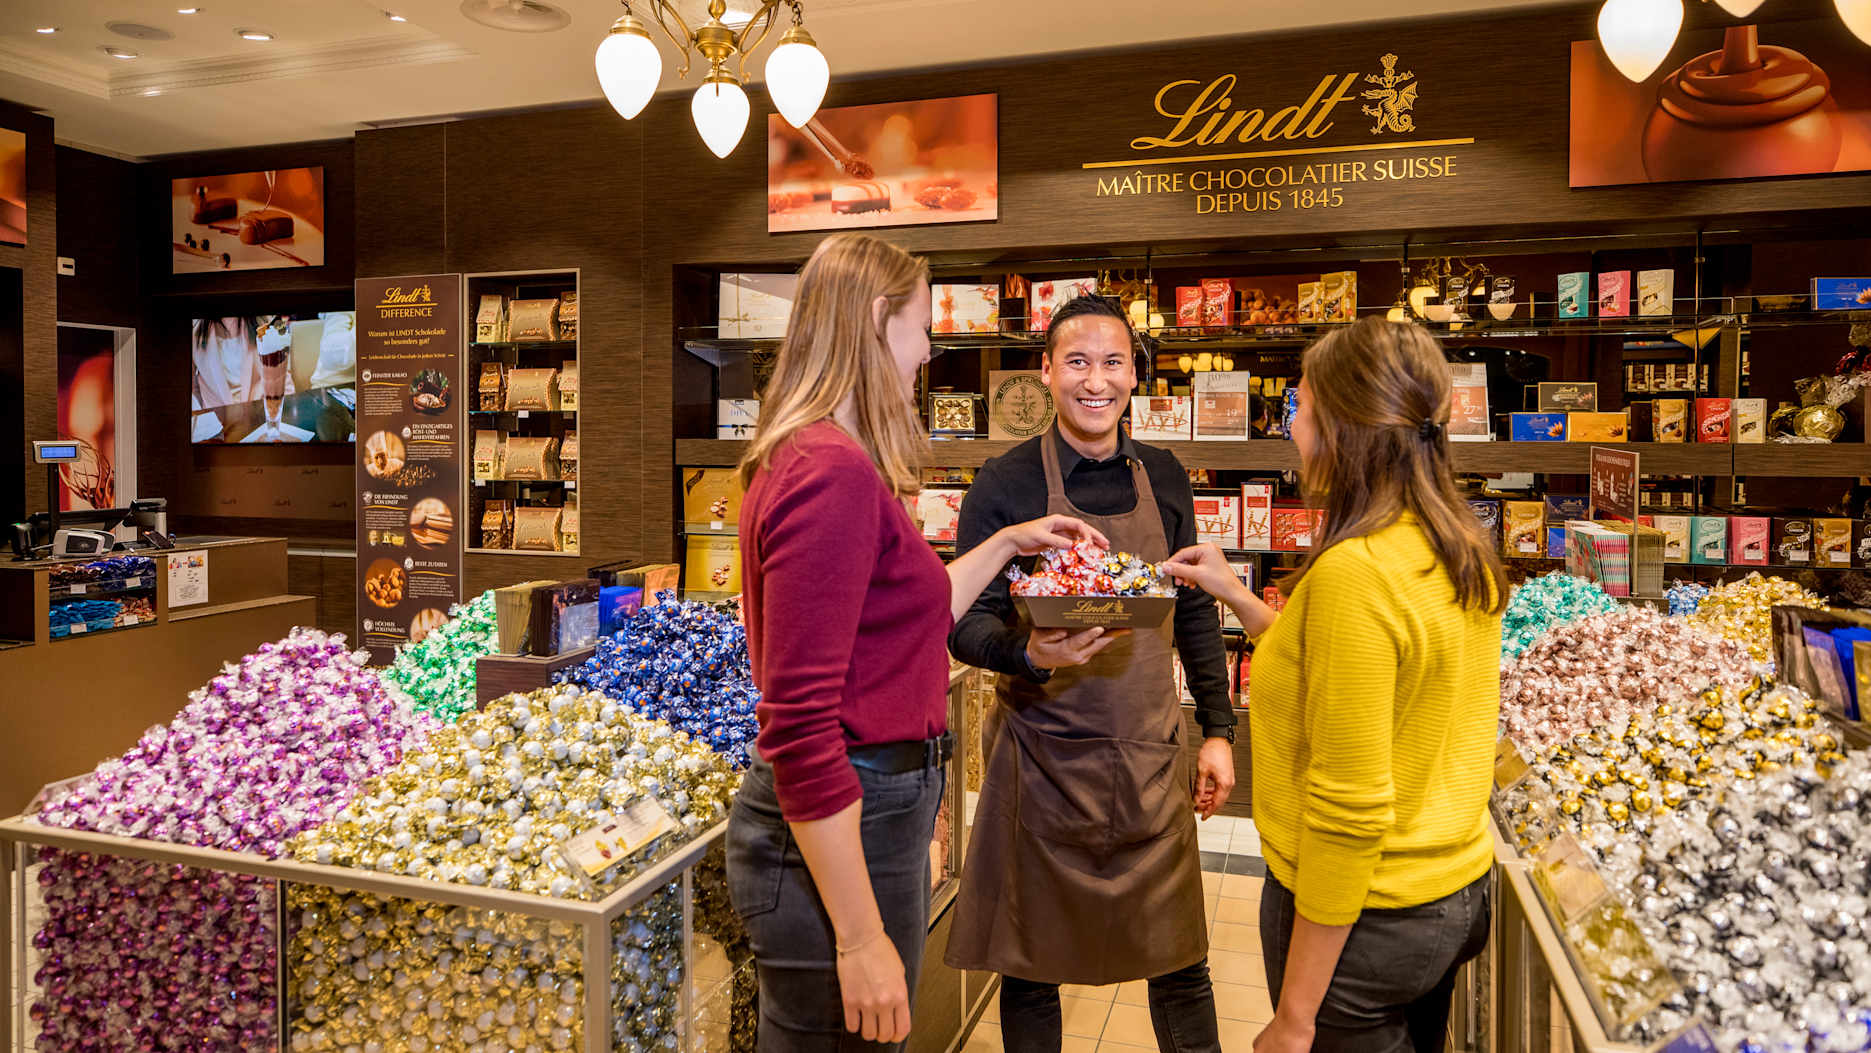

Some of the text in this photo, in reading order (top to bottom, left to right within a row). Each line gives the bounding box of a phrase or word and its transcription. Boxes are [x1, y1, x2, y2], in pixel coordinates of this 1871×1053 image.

[1130, 72, 1360, 150] Lindt
[1096, 156, 1457, 197] MAÎTRE CHOCOLATIER SUISSE
[1196, 187, 1344, 215] DEPUIS 1845
[381, 286, 422, 304] Lindt
[381, 307, 432, 319] DIFFERENCE
[396, 329, 414, 337] LINDT
[415, 328, 446, 336] Schokolade
[391, 337, 418, 345] besonders
[1072, 600, 1114, 613] Lindt
